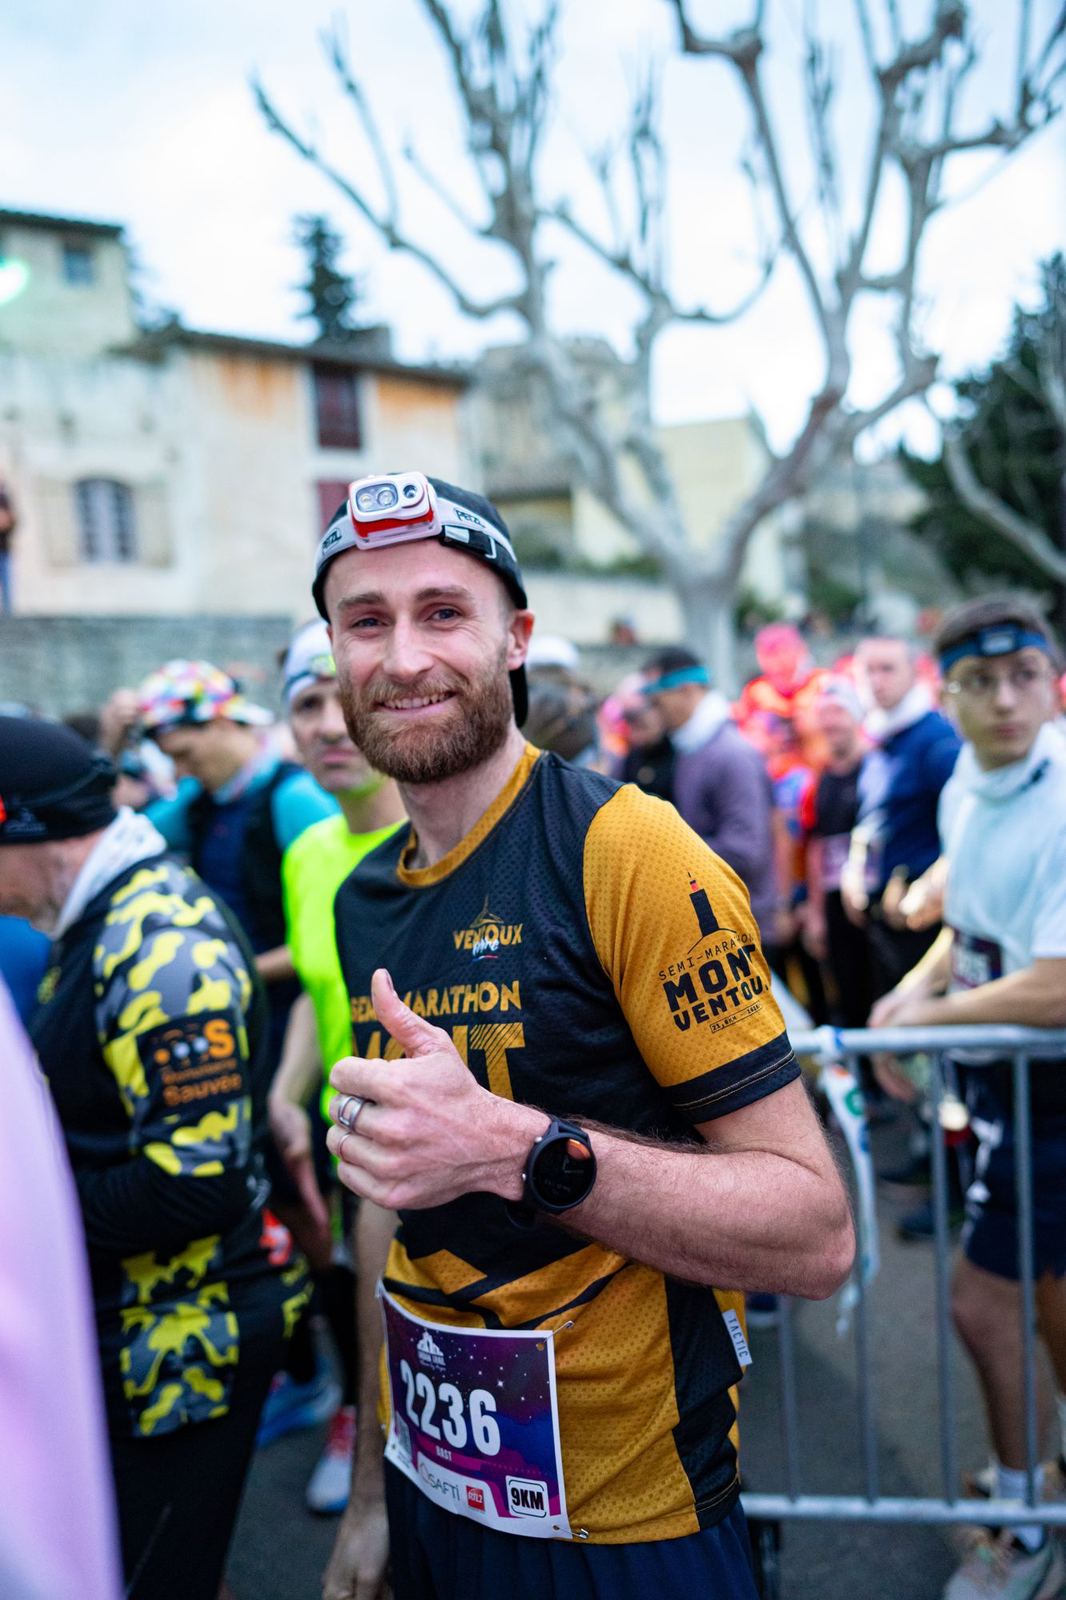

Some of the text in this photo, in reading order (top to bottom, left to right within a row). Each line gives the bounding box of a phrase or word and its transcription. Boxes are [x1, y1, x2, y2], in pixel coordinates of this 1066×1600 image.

[659, 934, 754, 980] SEMI-MARAO
[663, 944, 756, 1013] MONT
[351, 996, 376, 1023] SEM
[673, 976, 769, 1032] VENTOU
[728, 1318, 748, 1357] TACTIC
[400, 1359, 500, 1457] 2236
[511, 1486, 545, 1511] 9KM
